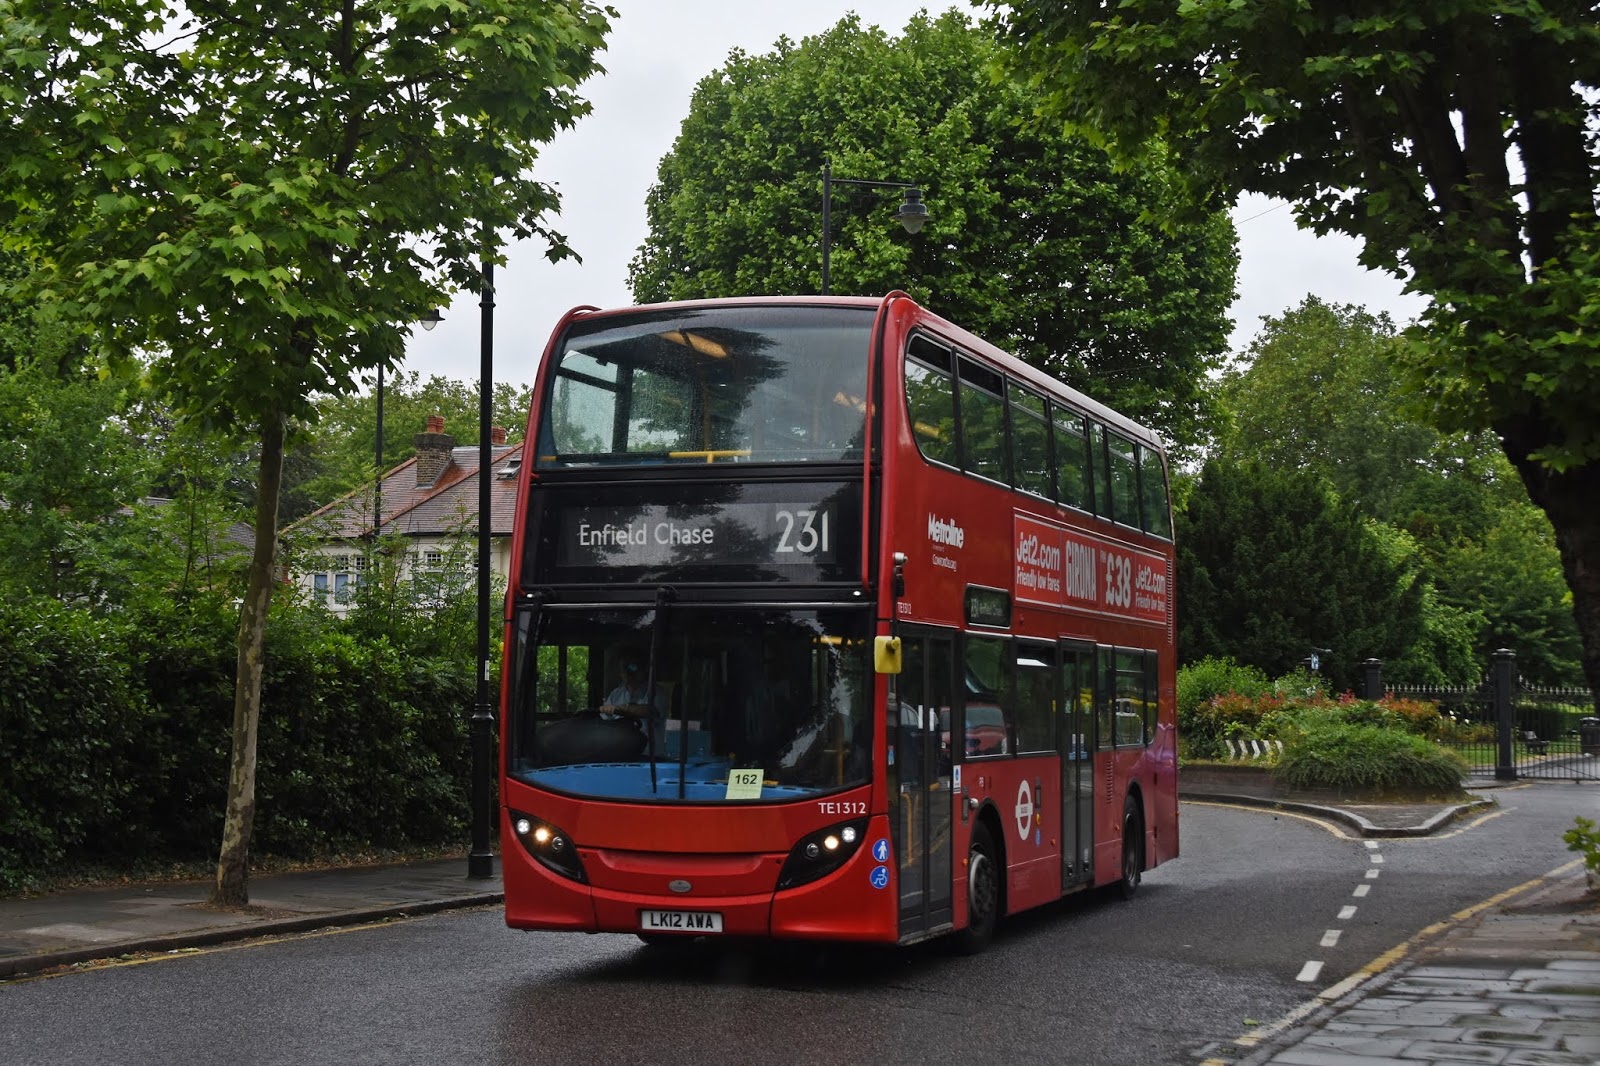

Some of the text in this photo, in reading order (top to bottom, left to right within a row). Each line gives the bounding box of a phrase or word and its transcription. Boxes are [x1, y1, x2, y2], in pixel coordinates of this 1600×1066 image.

[579, 510, 829, 553] Enfield Chase 231
[928, 511, 964, 549] Metroline
[1016, 531, 1060, 571] Jet2.com
[1016, 565, 1037, 592] Friendly
[1065, 540, 1131, 609] GIRONA £38
[735, 774, 758, 785] 162
[817, 802, 866, 814] TE1312
[650, 912, 714, 929] LK12 AWA
